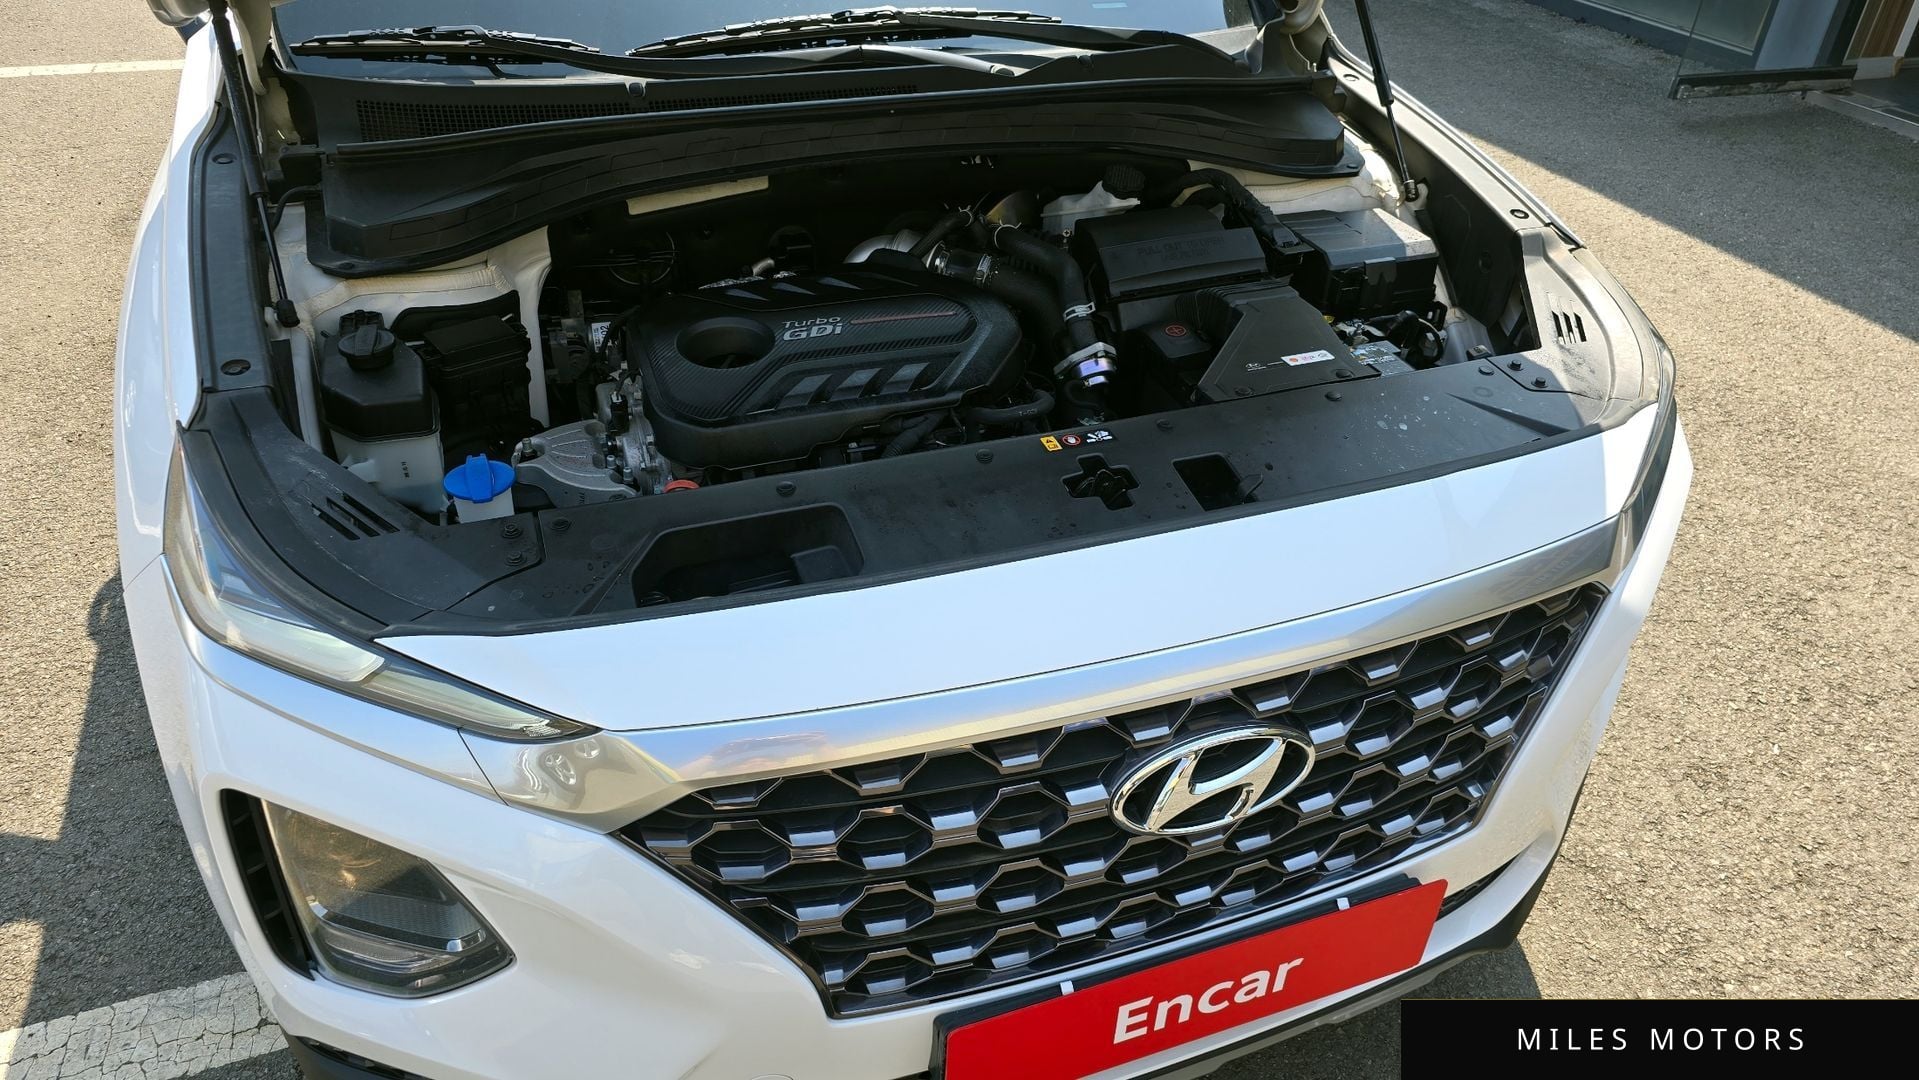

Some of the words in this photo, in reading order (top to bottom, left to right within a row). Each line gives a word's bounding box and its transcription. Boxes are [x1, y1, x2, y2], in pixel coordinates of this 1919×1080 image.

[782, 316, 841, 328] Turbo
[783, 323, 842, 341] GDi
[1113, 957, 1304, 1044] Encar
